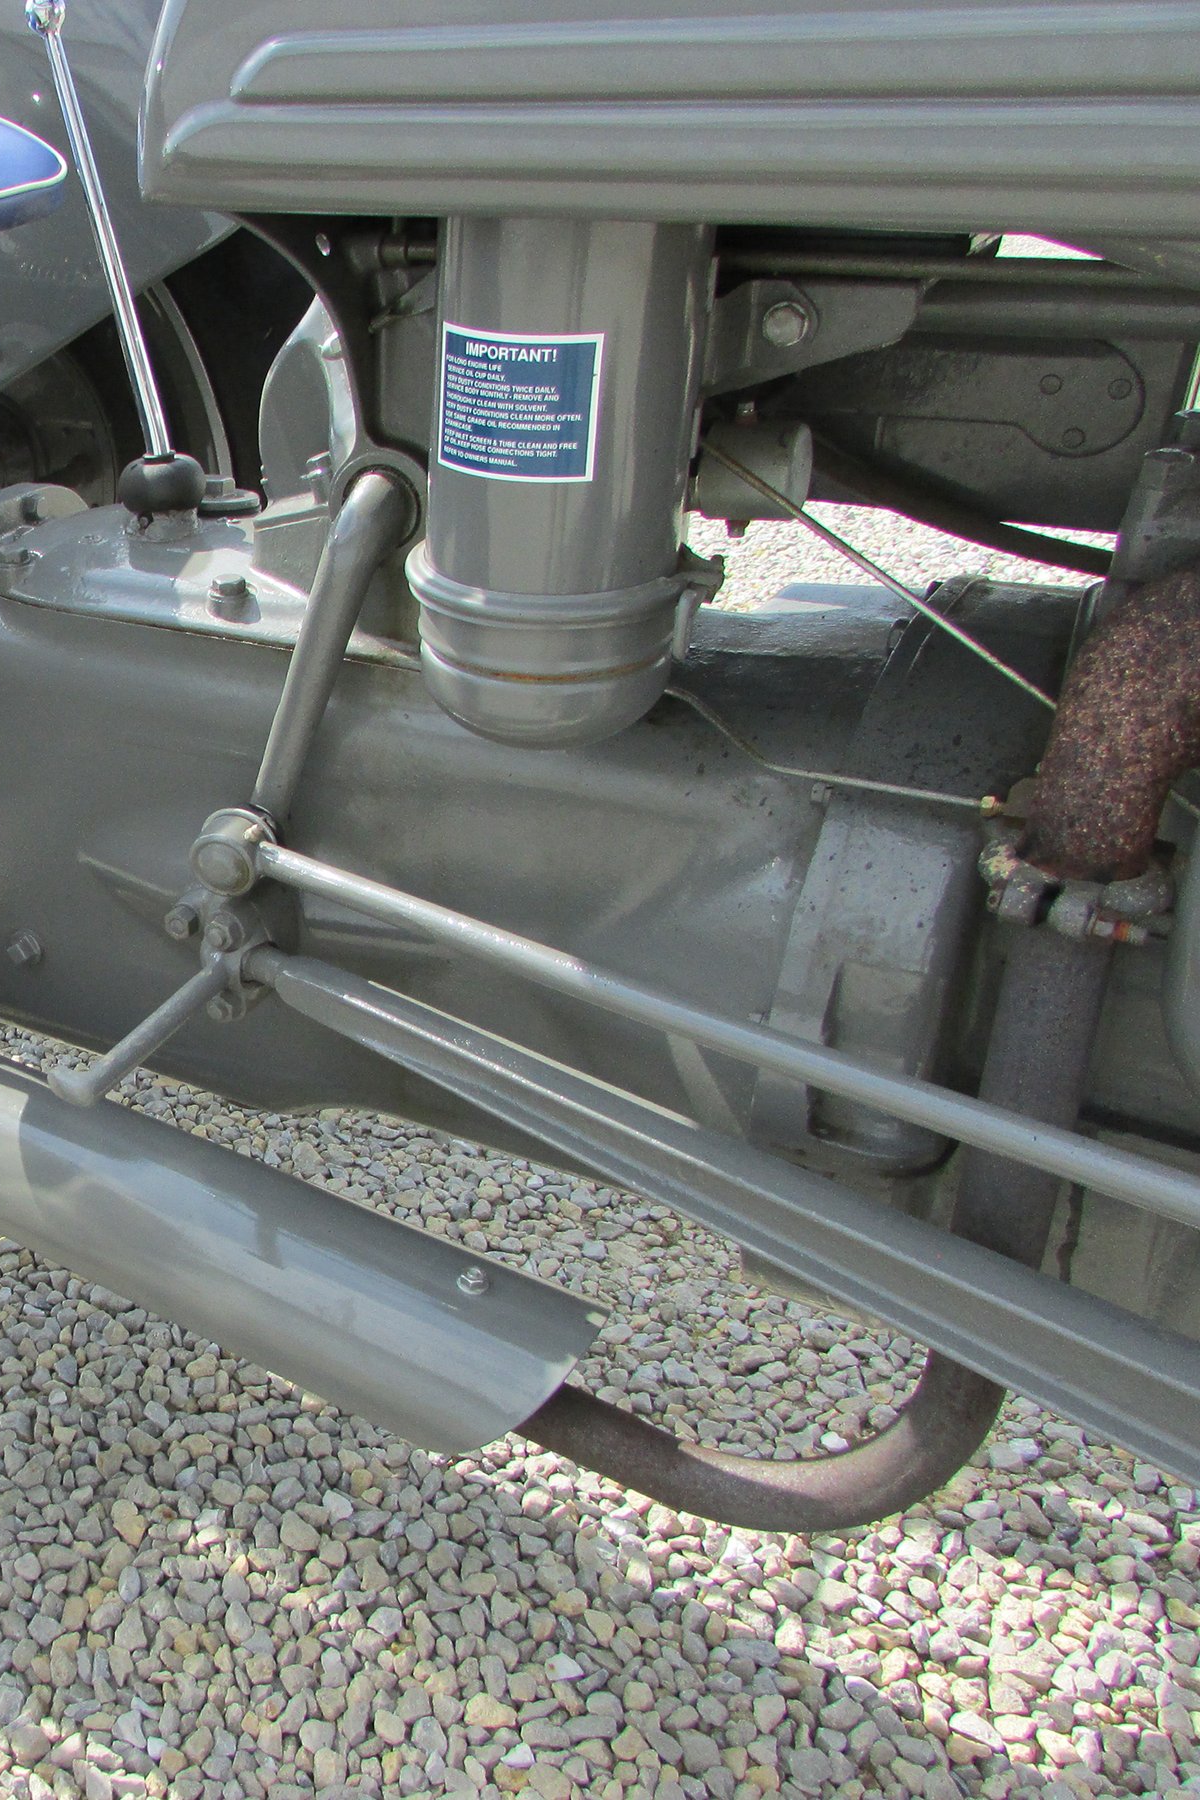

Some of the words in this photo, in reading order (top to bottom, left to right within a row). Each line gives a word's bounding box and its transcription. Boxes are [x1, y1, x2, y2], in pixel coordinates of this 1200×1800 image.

[466, 341, 557, 362] IMPORTANT!
[448, 364, 465, 375] SERVICE
[465, 369, 474, 377] OIL
[474, 371, 487, 379] CUP
[487, 373, 506, 382] DAILY.
[454, 356, 467, 366] LONG
[468, 360, 487, 370] ENGINE
[489, 363, 501, 372] LIFE
[447, 374, 457, 382] VERY
[457, 377, 474, 387] DUSTY
[474, 380, 510, 392] CONDITIONS
[512, 385, 533, 394] TWICE
[535, 386, 557, 394] DAILY.
[447, 381, 464, 392] SERVICE
[464, 386, 480, 395] BODY
[480, 389, 508, 400] MONTHLY
[513, 393, 542, 402] REMOVE
[544, 394, 559, 402] AND
[447, 391, 476, 405] THOROUGHLY
[476, 399, 497, 408] CLEAN
[497, 402, 514, 410] WITH
[515, 403, 547, 412] SOLVENT.
[453, 412, 466, 422] SAME
[467, 416, 486, 426] GRADE
[486, 420, 497, 428] OIL
[498, 422, 551, 431] RECOMMENDED
[457, 404, 472, 413] DUSTY
[473, 408, 509, 419] CONDITIONS
[510, 412, 533, 421] CLEAN
[535, 413, 555, 422] MORE
[557, 414, 582, 422] OFTEN.
[455, 431, 469, 441] INLET
[469, 435, 492, 445] SCREEN
[493, 439, 498, 447] &
[499, 440, 517, 449] TUBE
[518, 442, 541, 450] CLEAN
[543, 442, 558, 450] AND
[464, 452, 488, 463] OWNERS
[489, 457, 518, 467] MANUAL.
[470, 443, 486, 452] HOSE
[487, 446, 534, 457] CONNECTIONS
[536, 449, 558, 458] TIGHT.
